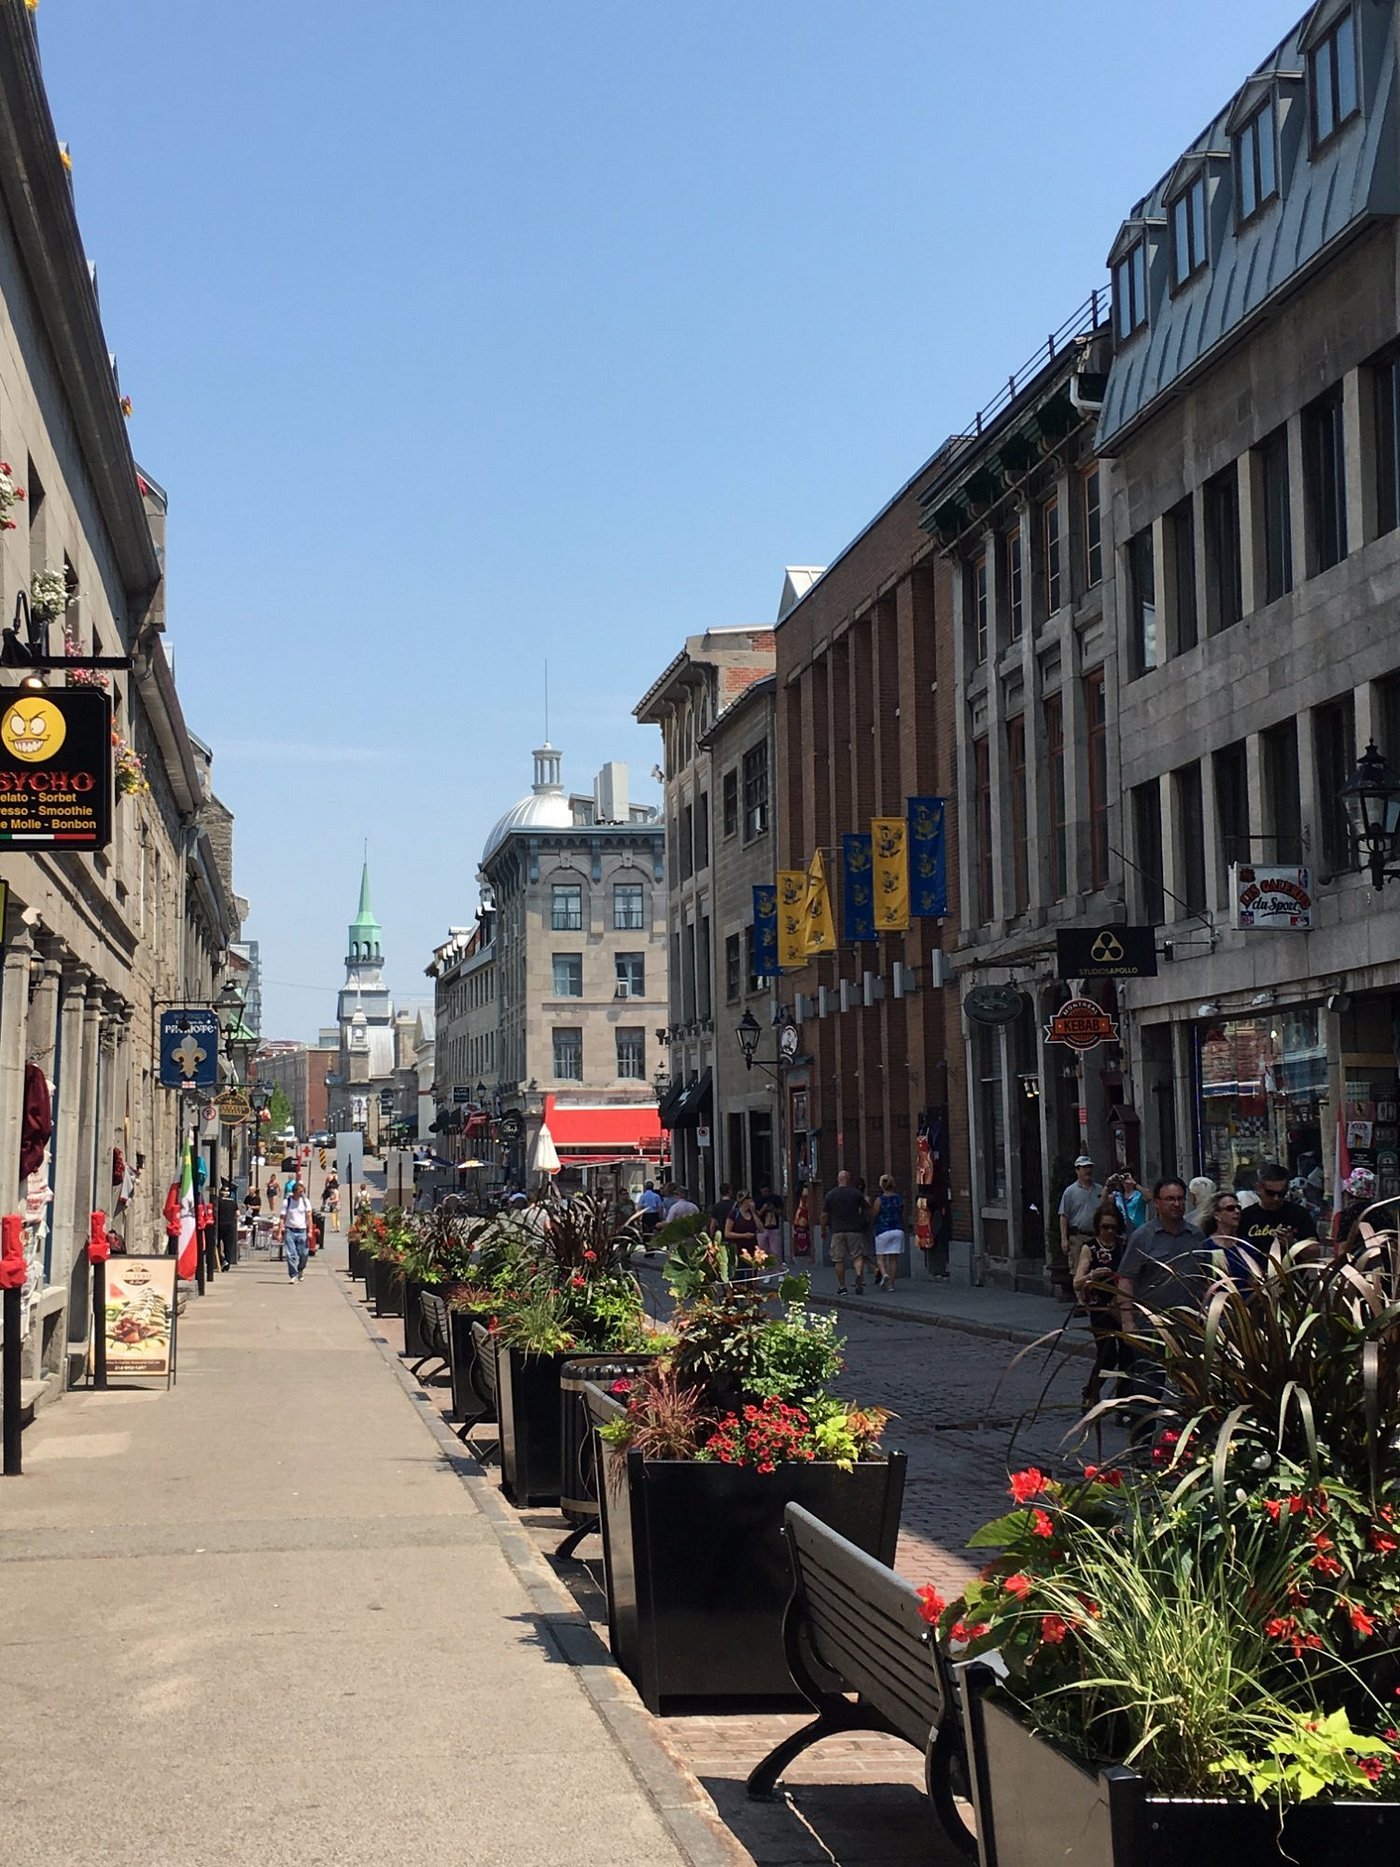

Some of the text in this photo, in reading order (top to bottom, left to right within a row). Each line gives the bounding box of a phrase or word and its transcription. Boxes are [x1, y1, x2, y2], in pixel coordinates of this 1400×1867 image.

[38, 792, 77, 802] Sorbet
[0, 806, 29, 815] esso
[38, 805, 93, 815] Smoothie
[11, 819, 42, 829] Molle
[51, 819, 97, 829] Bonbon
[1252, 897, 1301, 915] du Sport
[1064, 1019, 1100, 1032] KEBAB
